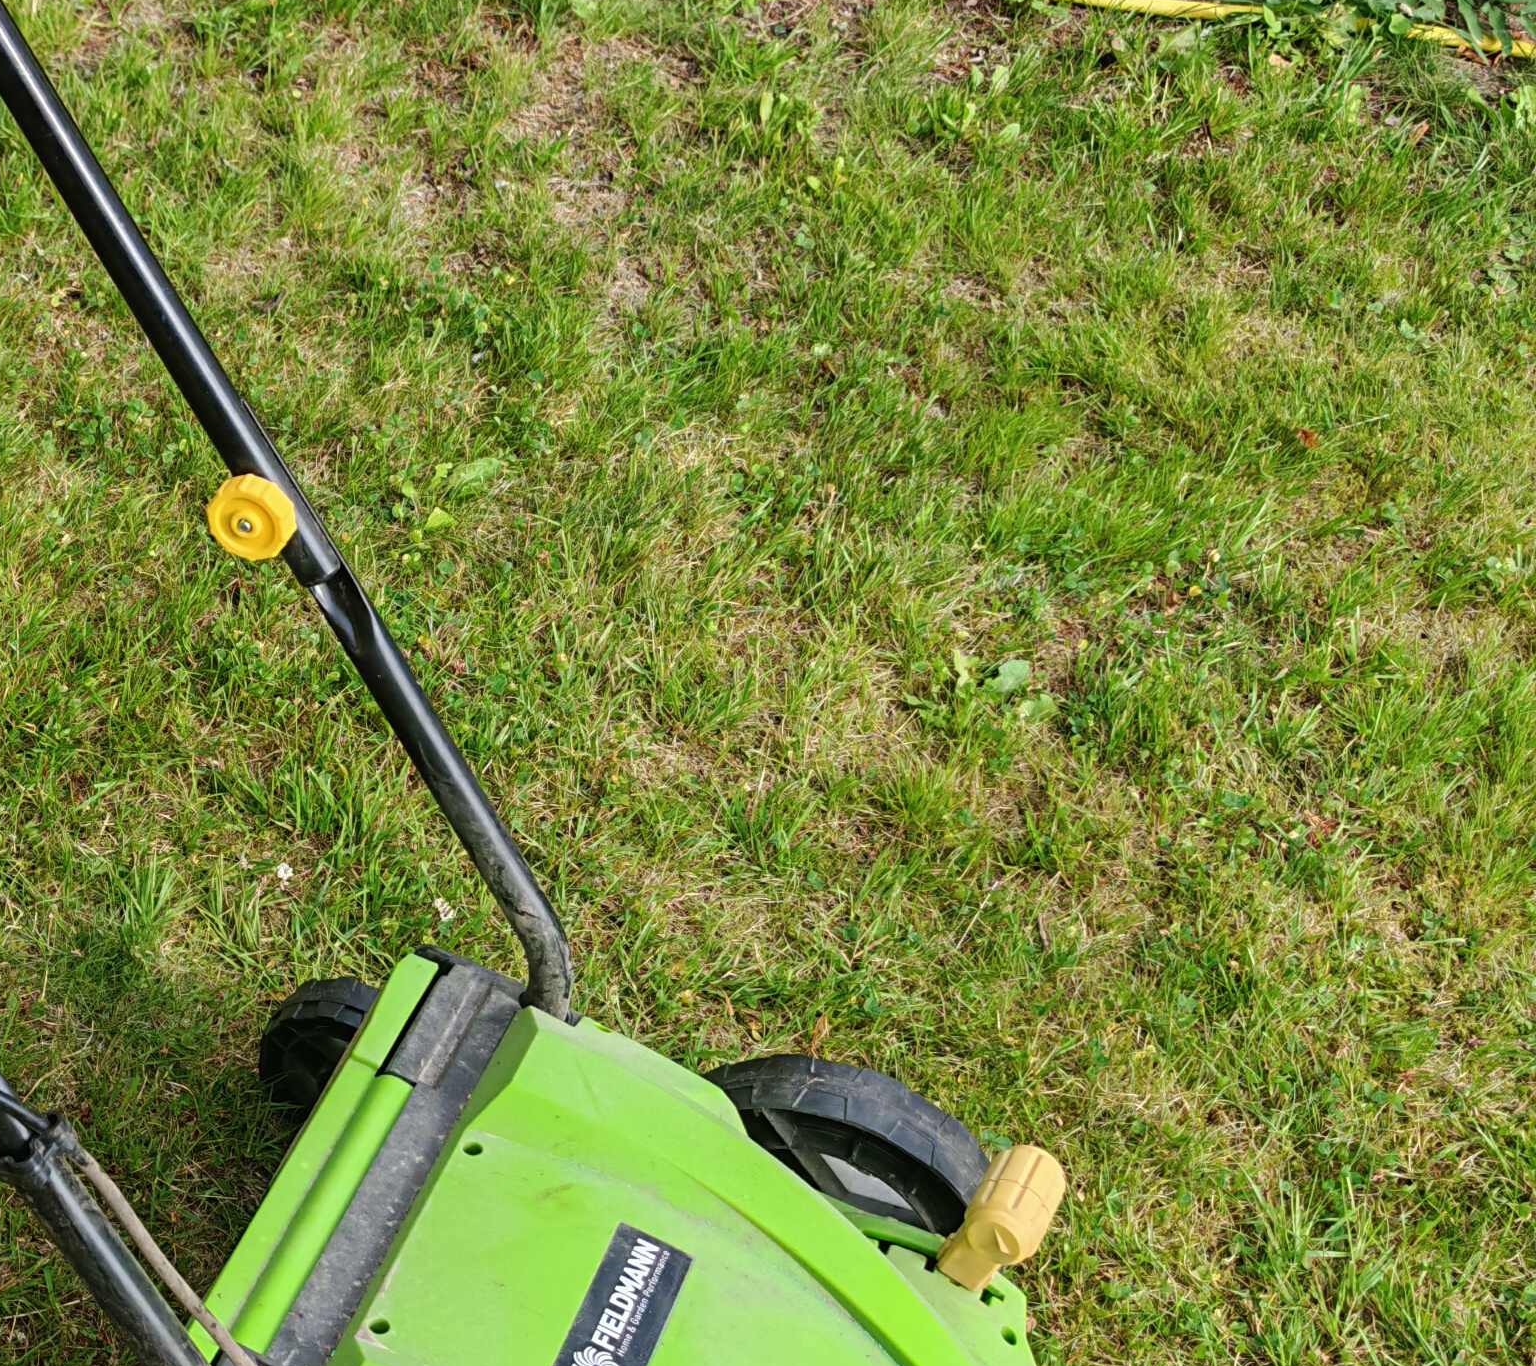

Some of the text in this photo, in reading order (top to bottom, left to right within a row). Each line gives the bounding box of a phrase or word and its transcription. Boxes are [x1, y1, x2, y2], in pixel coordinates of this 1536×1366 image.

[591, 1238, 660, 1351] FIELDMANN
[616, 1250, 671, 1357] Home & Garden Performance
